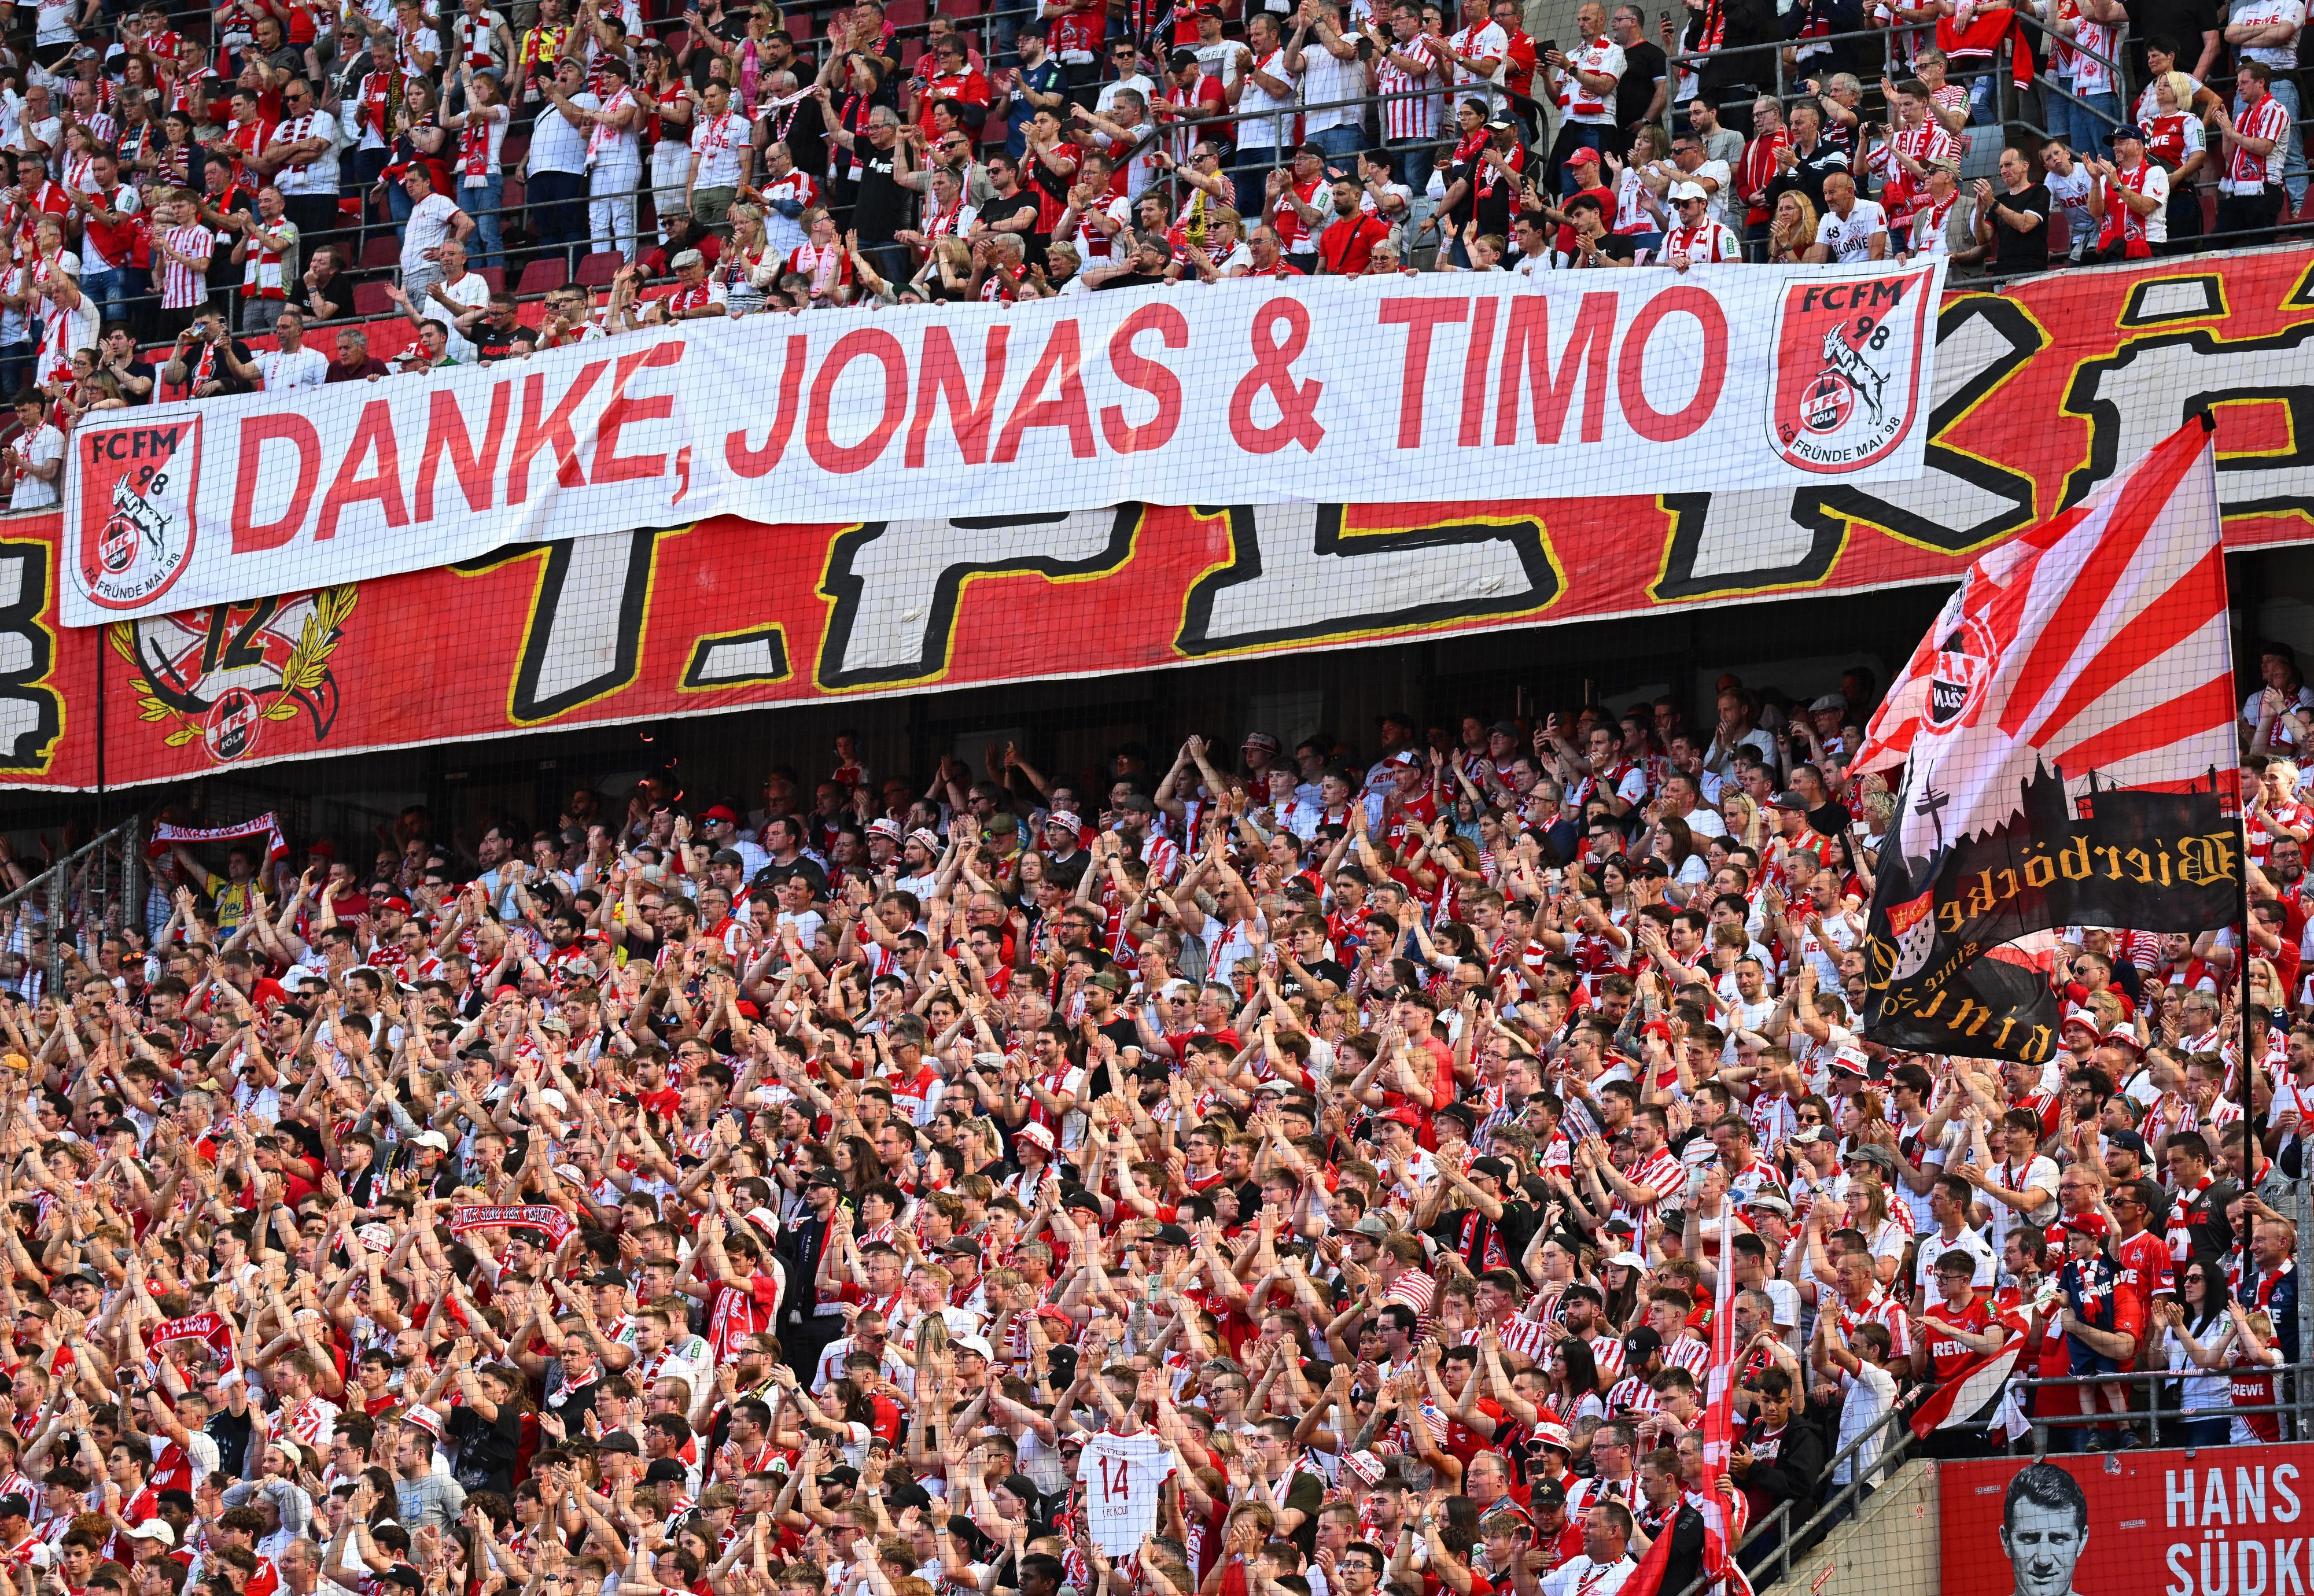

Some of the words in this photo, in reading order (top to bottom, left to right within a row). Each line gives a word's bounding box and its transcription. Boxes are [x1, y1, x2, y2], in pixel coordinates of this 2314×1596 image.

[1456, 44, 1481, 58] RWE
[925, 87, 958, 97] RWE
[1960, 93, 1969, 109] DEVK
[2150, 134, 2170, 148] WE
[869, 157, 894, 174] RWE
[1318, 194, 1329, 208] DEVK
[2060, 193, 2090, 209] REW
[1826, 226, 1840, 239] 48
[1726, 237, 1736, 255] DEVK
[1833, 237, 1869, 256] OLOGNE
[1802, 279, 1904, 312] FCFM
[1852, 316, 1890, 351] 98
[1808, 390, 1842, 415] 1.FC
[231, 340, 691, 555] DANKE,
[725, 302, 1189, 479] JONAS
[1229, 296, 1326, 454] &
[1378, 285, 1728, 449] TIMO
[1811, 409, 1837, 426] KÖLN
[93, 427, 178, 464] FCFM
[1778, 422, 1796, 444] FC
[1793, 438, 1851, 462] FRÜNDE
[1856, 436, 1884, 458] MAI
[136, 465, 169, 496] 98
[103, 530, 126, 552] 1.FC
[106, 545, 124, 562] KÖLN
[83, 566, 96, 585] FC
[97, 582, 143, 599] FRÜNDE
[145, 569, 165, 589] MAI
[215, 709, 249, 740] 1.FC
[221, 730, 245, 751] KÖLN
[1372, 771, 1395, 784] REW
[1389, 824, 1409, 837] EW
[1103, 890, 1117, 904] RE
[1211, 931, 1237, 948] RE
[1285, 983, 1303, 996] RE
[1797, 1060, 1818, 1074] RE
[892, 1103, 915, 1118] EWE
[2165, 1211, 2209, 1230] RWE
[2120, 1269, 2138, 1284] WE
[2079, 1281, 2113, 1303] RWE
[1337, 1300, 1350, 1313] RE
[1704, 1309, 1714, 1322] DEV
[171, 1321, 184, 1336] FC
[185, 1315, 211, 1333] KÖLN
[1628, 1339, 1637, 1351] NY
[1933, 1341, 1973, 1358] REW
[2231, 1383, 2264, 1396] REWE
[1097, 1455, 1129, 1504] 14
[1360, 1467, 1377, 1485] KÖLN
[2165, 1463, 2300, 1527] HANS
[1106, 1508, 1114, 1517] FC
[1187, 1527, 1202, 1563] Köln
[2166, 1530, 2314, 1596] SÜDK
